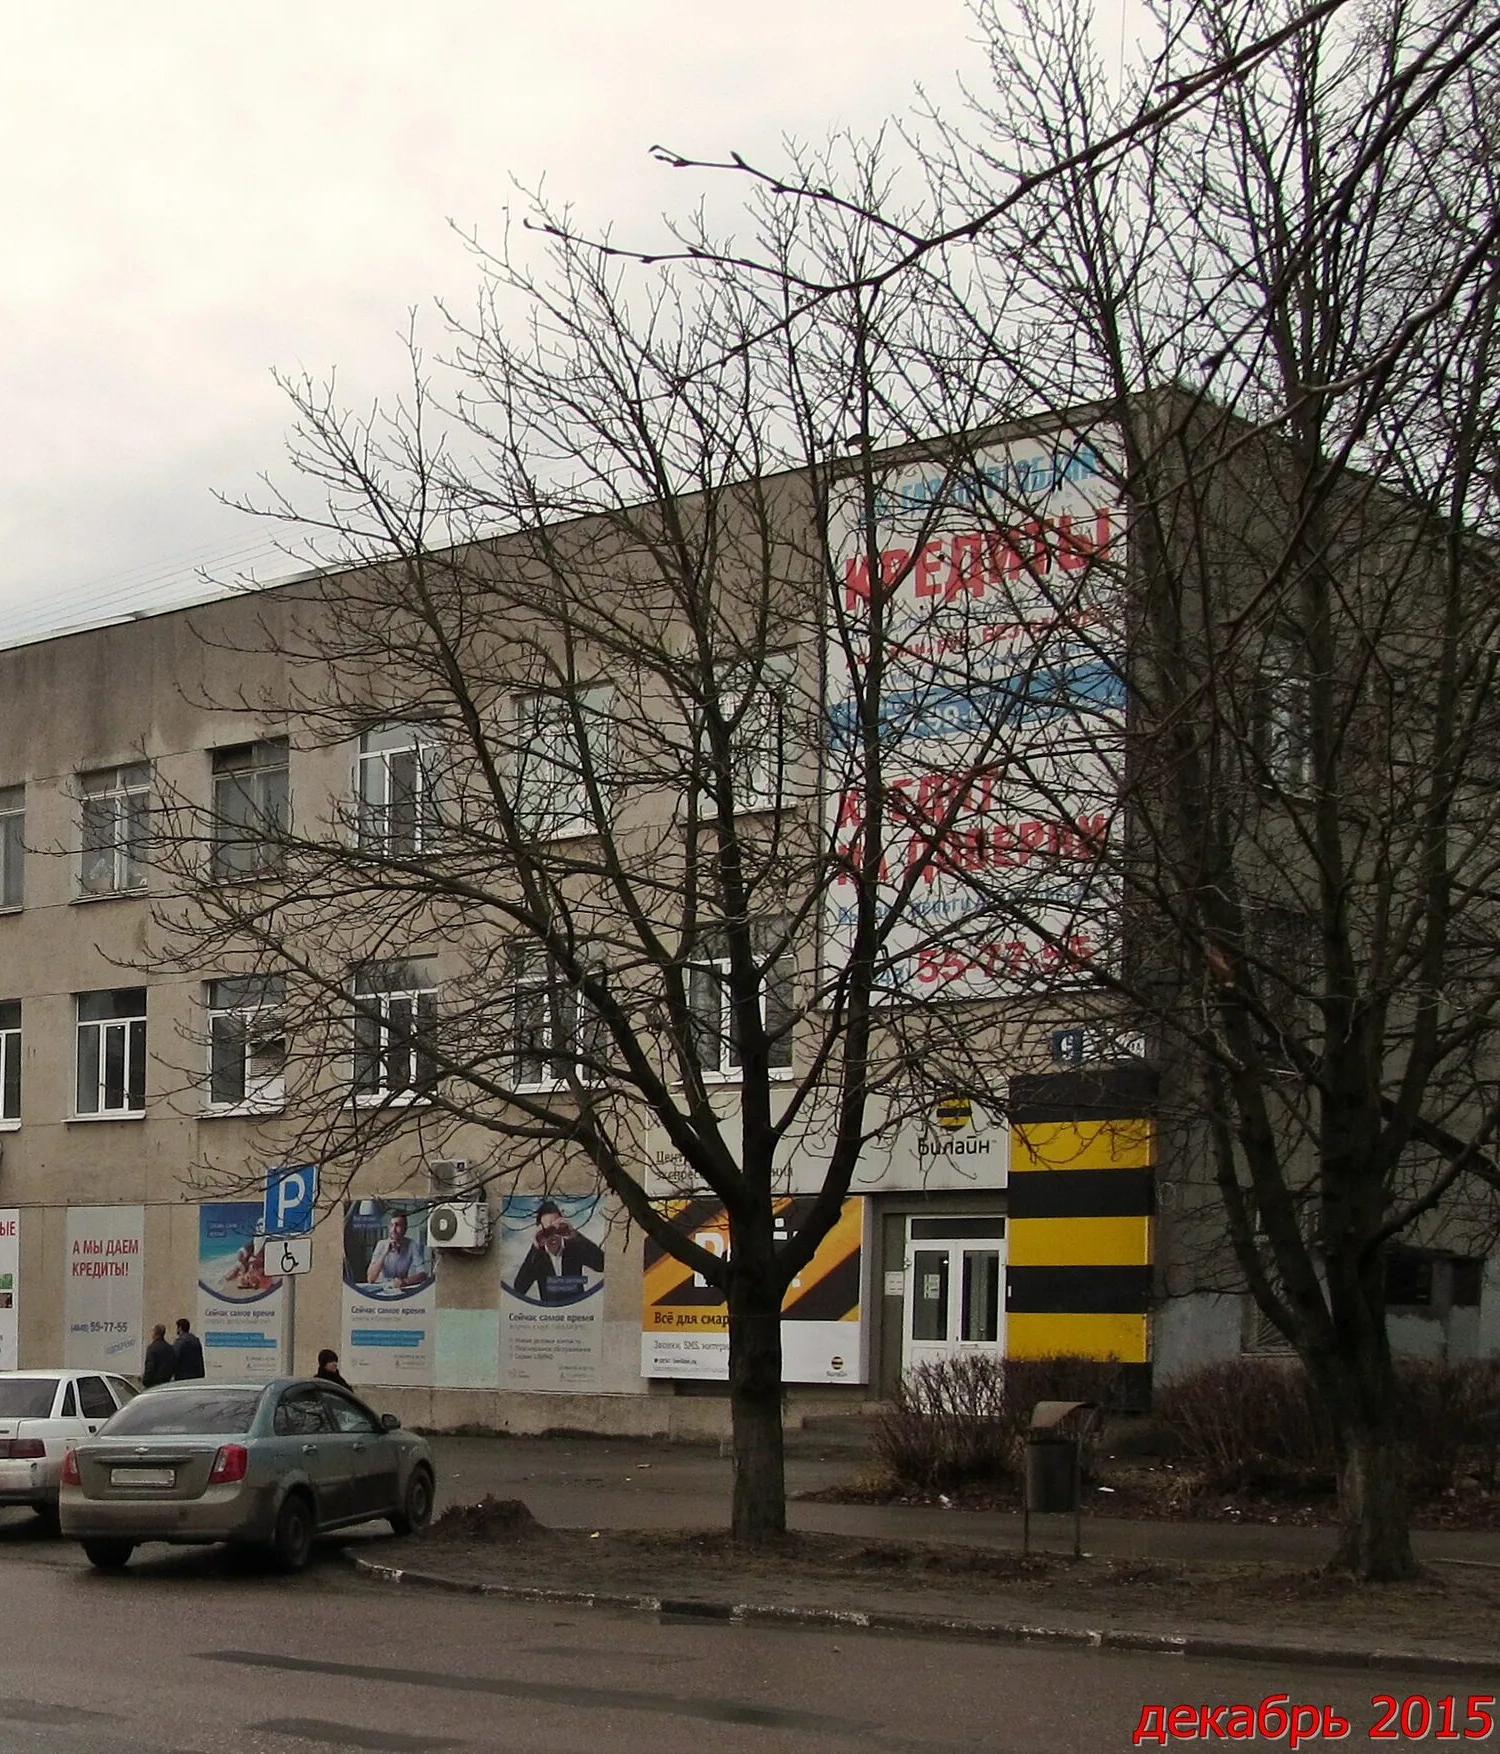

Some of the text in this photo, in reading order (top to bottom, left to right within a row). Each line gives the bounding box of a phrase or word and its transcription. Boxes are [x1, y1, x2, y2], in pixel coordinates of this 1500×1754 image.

[846, 507, 1109, 610] КРЕДИТЫ
[277, 1173, 306, 1228] P
[73, 1240, 139, 1256] А МЫ ДАЕМ
[72, 1262, 129, 1278] КРЕДИТЫ!
[205, 1308, 227, 1317] Сейчас
[351, 1305, 375, 1313] Сейчас
[509, 1312, 536, 1321] Сейчас
[567, 1315, 594, 1323] время
[654, 1312, 674, 1324] Всё
[677, 1315, 697, 1326] для
[90, 1322, 128, 1333] 55-77-55
